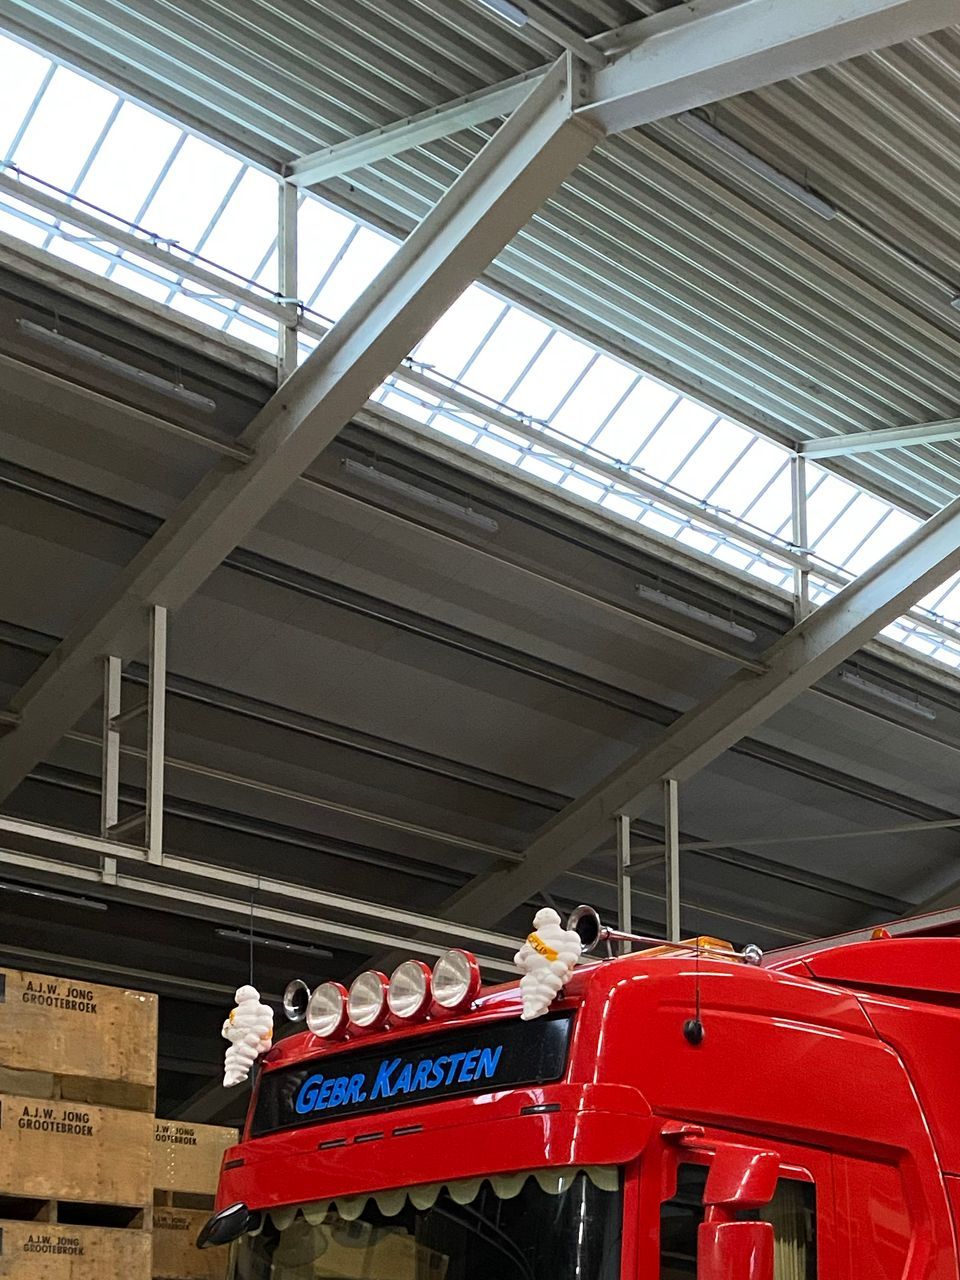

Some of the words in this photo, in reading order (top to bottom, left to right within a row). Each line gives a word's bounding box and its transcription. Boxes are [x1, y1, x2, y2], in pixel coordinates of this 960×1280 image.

[26, 981, 60, 997] A.J.W.
[65, 988, 94, 1001] JONG
[22, 992, 97, 1014] GROOTEBROEK
[295, 1073, 367, 1115] GEBR.
[370, 1046, 503, 1100] KARSTEN
[22, 1106, 57, 1121] A.J.W.
[61, 1110, 90, 1124] JONG
[18, 1119, 93, 1137] GROOTEBROEK
[175, 1128, 194, 1137] JONG
[28, 1235, 51, 1245] A.J.W.
[57, 1237, 80, 1246] JONG
[23, 1244, 84, 1256] GROOTEBROEK
